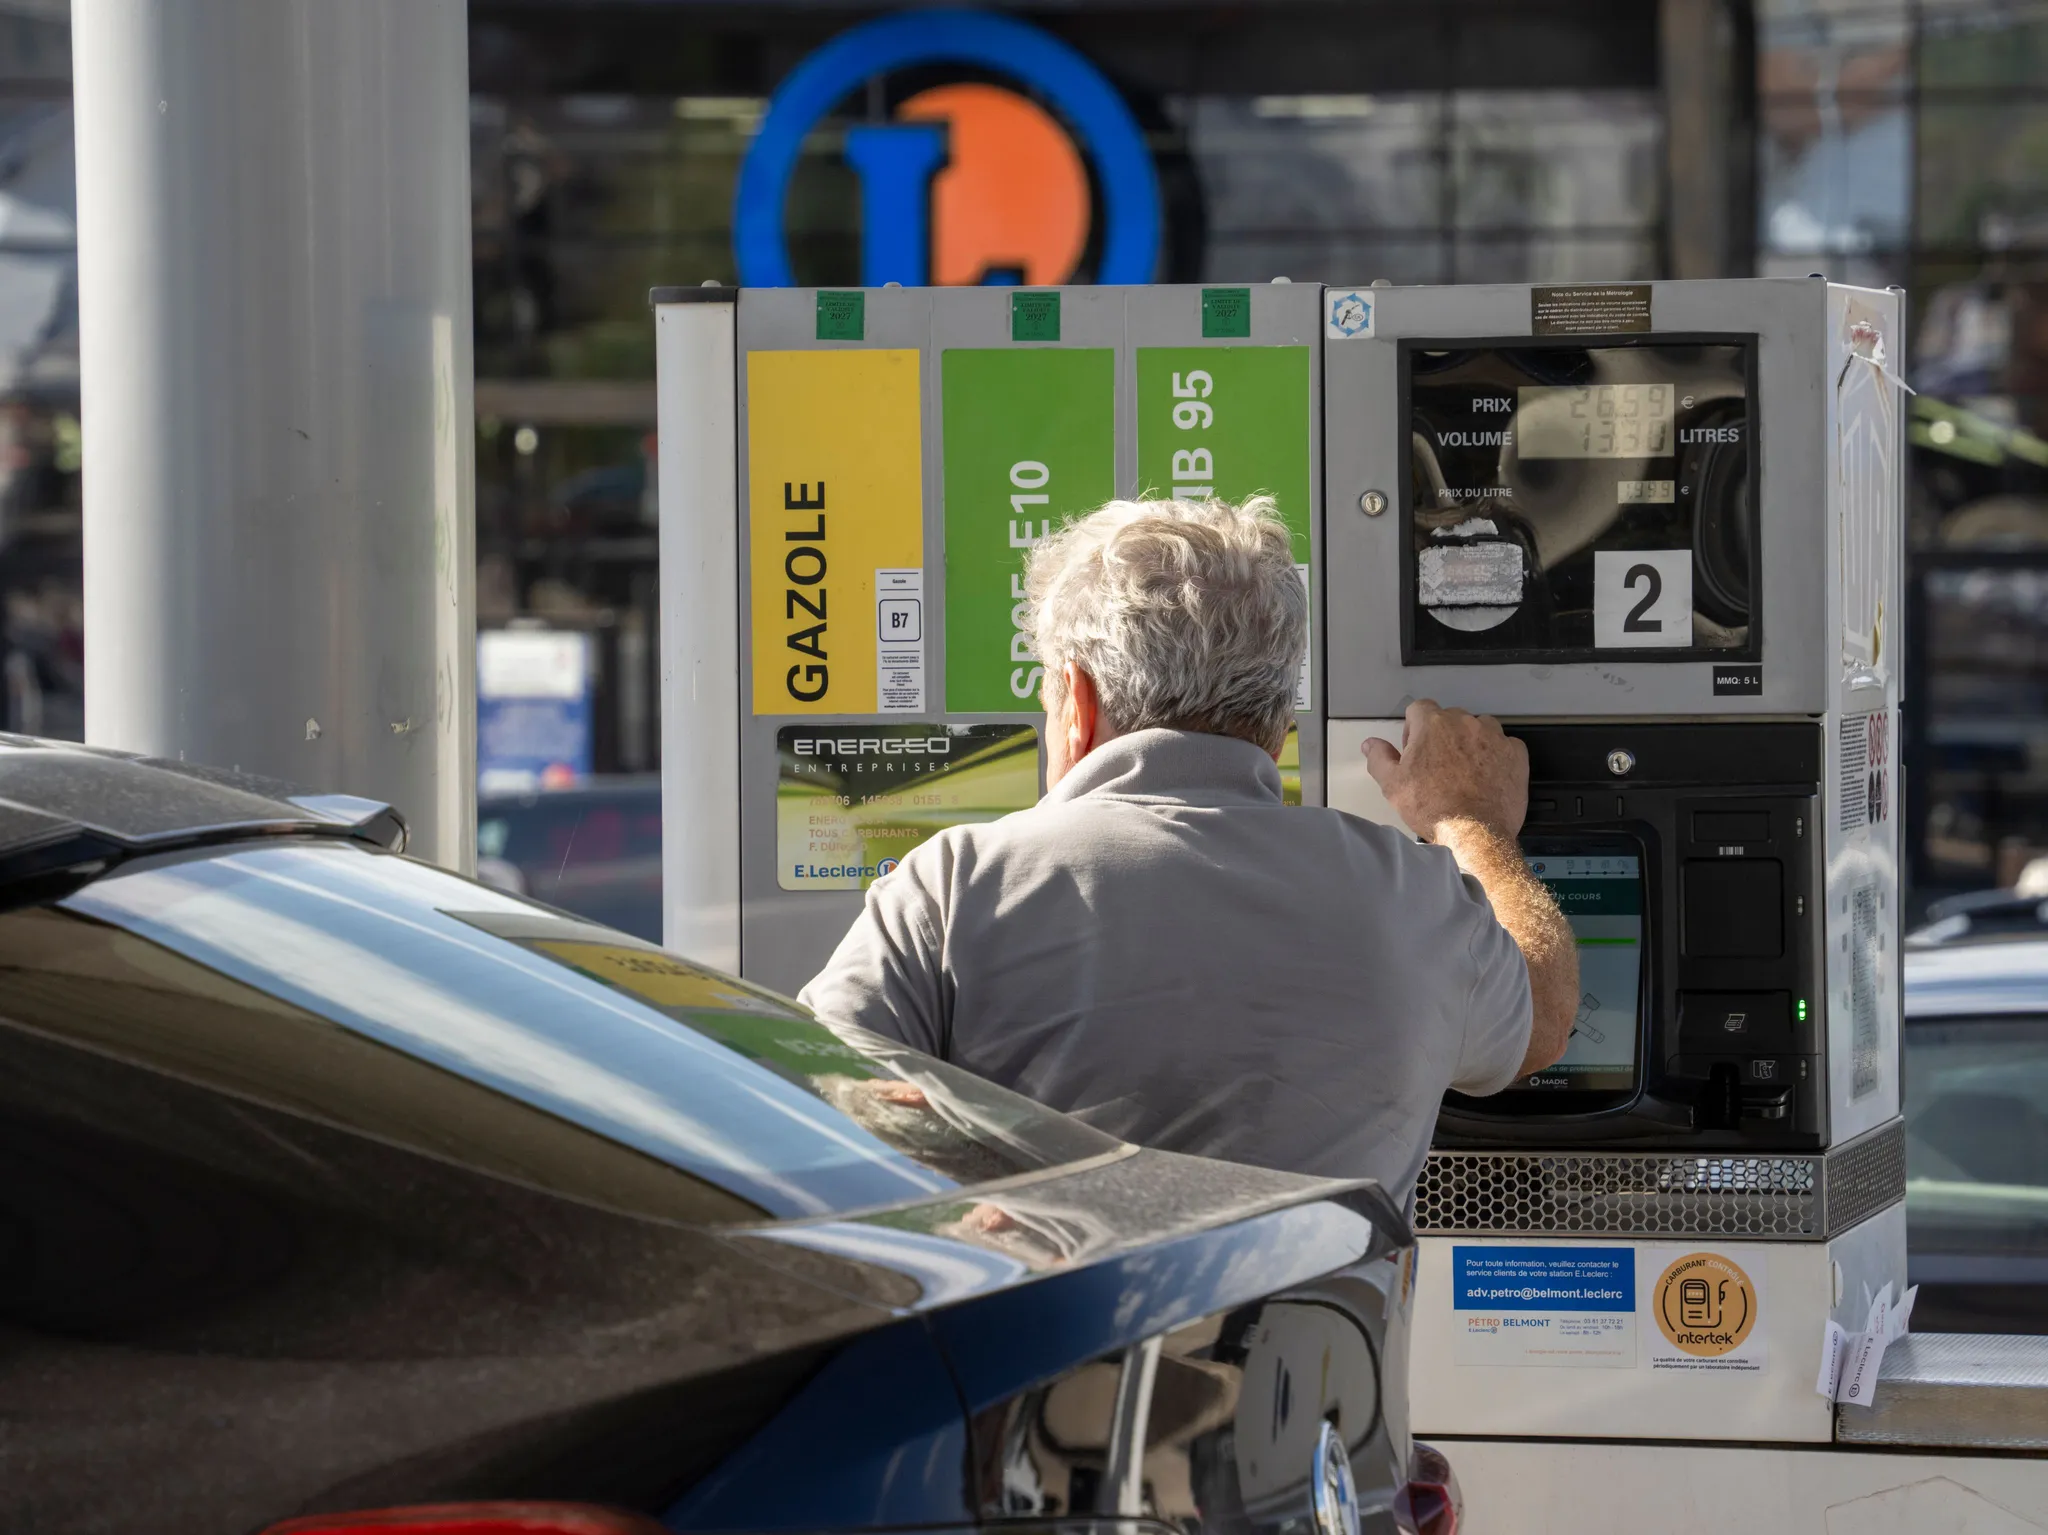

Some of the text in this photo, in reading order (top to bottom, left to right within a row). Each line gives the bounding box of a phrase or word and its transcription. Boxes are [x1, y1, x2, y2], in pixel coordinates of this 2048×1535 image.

[829, 312, 851, 320] 2027
[1025, 313, 1047, 321] 2027
[1172, 370, 1213, 430] 95
[1472, 398, 1512, 413] PRIX
[1681, 395, 1694, 409] €
[1437, 431, 1512, 447] VOLUME
[1680, 428, 1739, 443] LITRES
[1438, 487, 1513, 498] PRIX DU LITRE
[1681, 485, 1690, 495] €
[784, 481, 828, 702] GAZOLE
[1623, 563, 1662, 633] 2
[891, 612, 909, 629] B7
[1716, 676, 1759, 685] MMQ: 5 L
[793, 737, 950, 755] ENERGEO
[794, 762, 950, 773] ENTREPRISES
[809, 829, 838, 839] TOUS
[809, 842, 817, 852] F.
[794, 864, 875, 878] E.Leclerc
[1466, 1259, 1484, 1267] Pour
[1504, 1260, 1547, 1268] information,
[1612, 1261, 1619, 1269] le
[1466, 1269, 1492, 1277] service
[1493, 1269, 1517, 1277] clients
[1518, 1269, 1528, 1277] de
[1575, 1269, 1609, 1278] E.Leclerc
[1665, 1259, 1707, 1286] CARBURANT
[1466, 1287, 1623, 1300] adv.petro@belmont.leclerc
[1468, 1317, 1551, 1327] PÉTRO BELMONT
[1677, 1331, 1734, 1345] intertek
